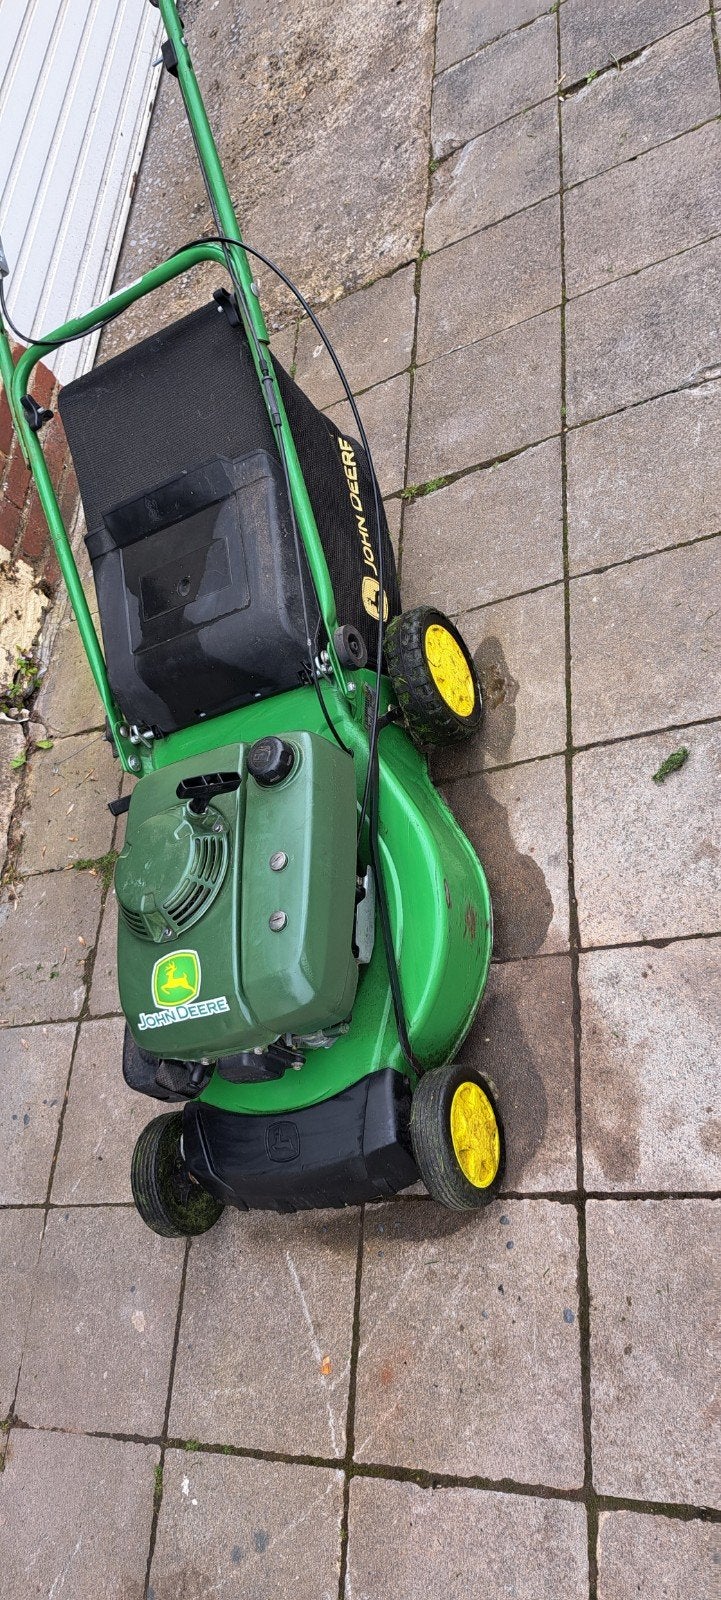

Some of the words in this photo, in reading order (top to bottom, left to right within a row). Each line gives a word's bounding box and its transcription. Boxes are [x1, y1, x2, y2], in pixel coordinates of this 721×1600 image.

[356, 514, 378, 576] JOHN
[140, 1010, 176, 1029] JOHN
[175, 999, 227, 1019] DEERE
